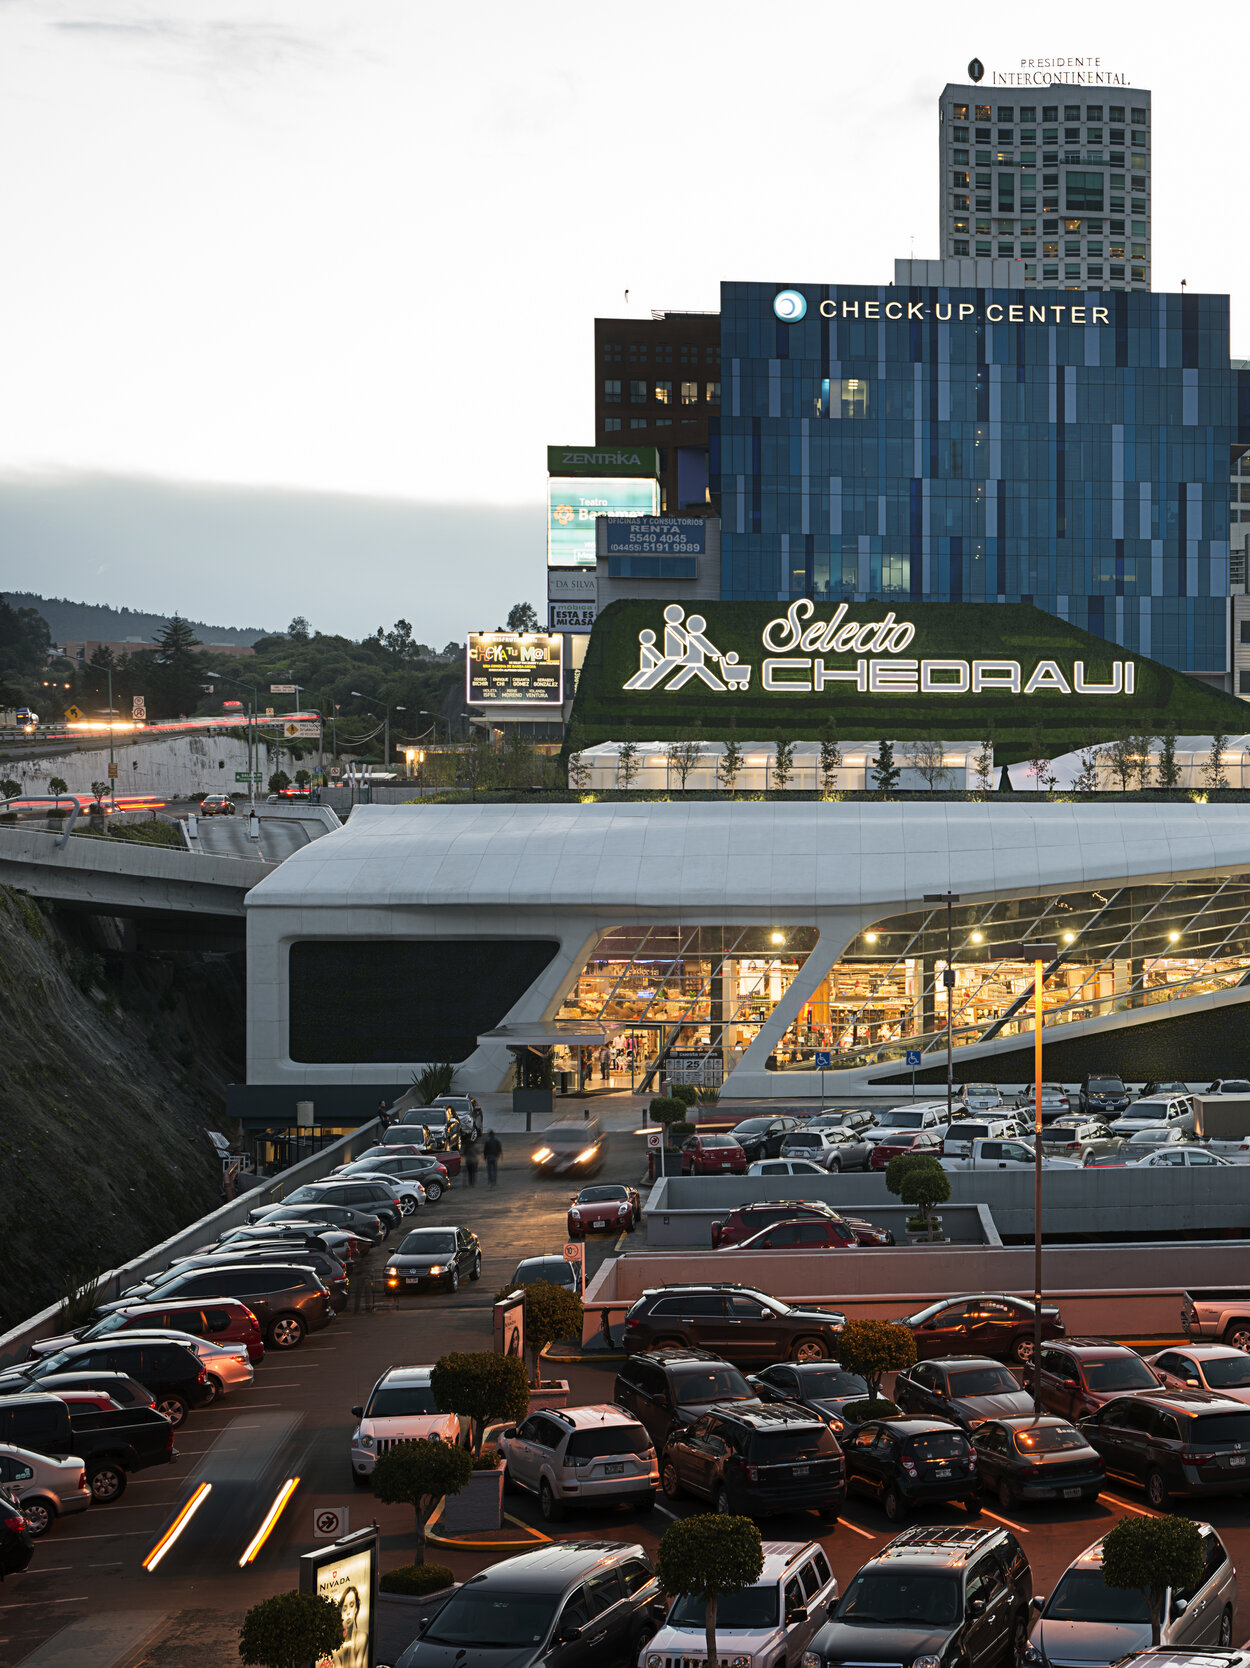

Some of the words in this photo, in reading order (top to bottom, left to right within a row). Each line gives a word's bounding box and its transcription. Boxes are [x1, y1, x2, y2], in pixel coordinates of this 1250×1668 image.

[1020, 57, 1101, 68] PRESIDENTE
[819, 300, 975, 322] CHECK-UP
[986, 304, 1110, 325] CENTER
[579, 497, 608, 506] Teatro
[630, 525, 680, 533] RENTA
[629, 534, 656, 542] 5540
[660, 534, 687, 543] 4045
[610, 543, 641, 551] (04455)
[643, 543, 669, 551] 5191
[673, 543, 700, 552] 9989
[762, 598, 916, 653] Selecto
[762, 658, 1135, 695] CHEDRAUI
[319, 1576, 351, 1592] NIVADA
